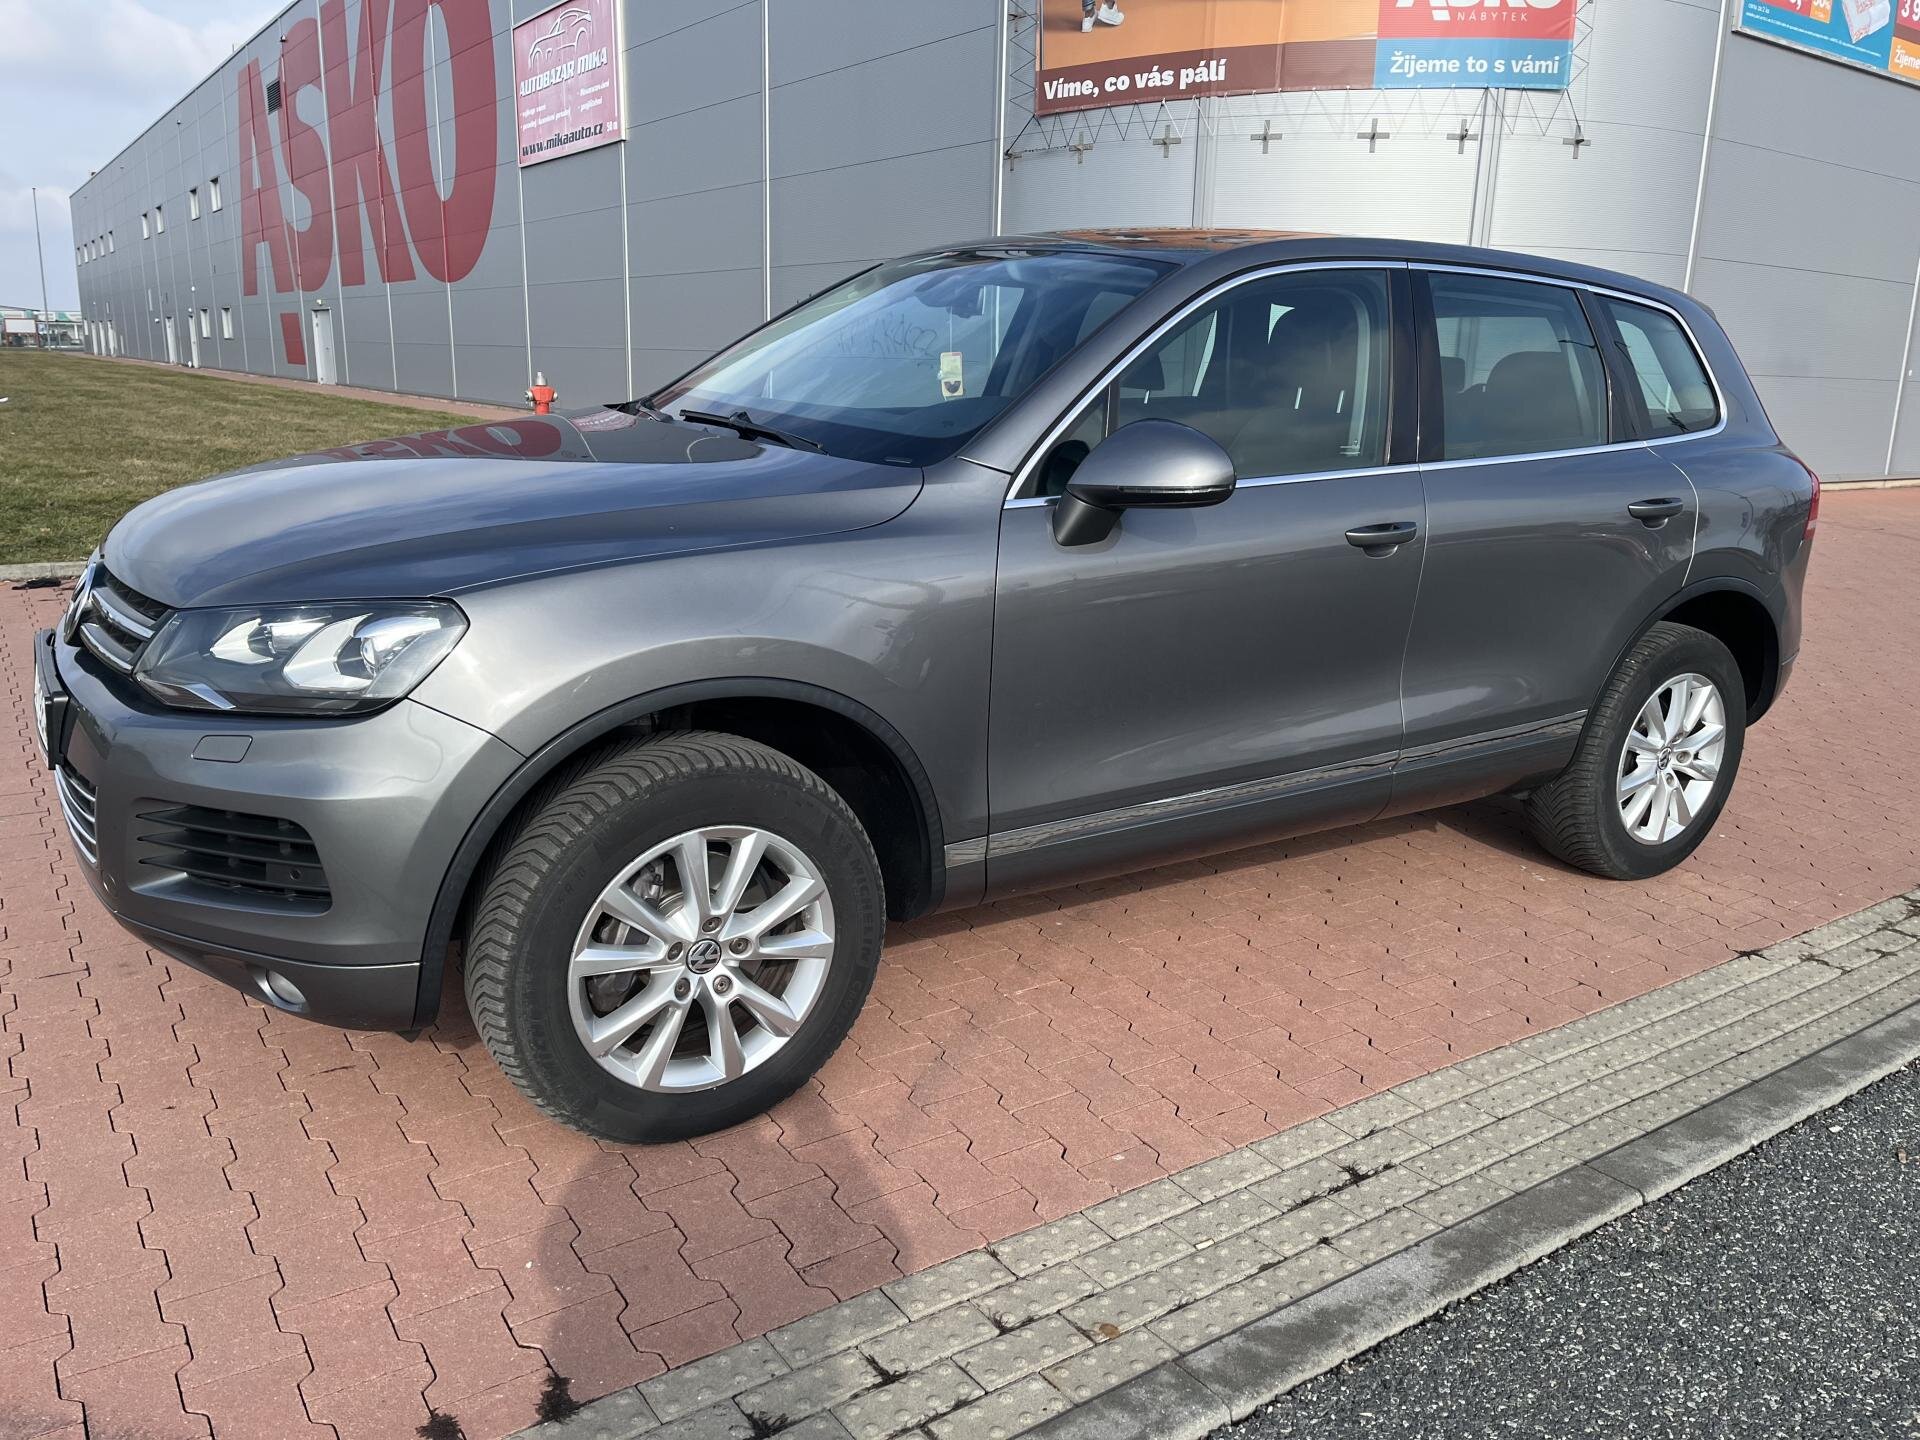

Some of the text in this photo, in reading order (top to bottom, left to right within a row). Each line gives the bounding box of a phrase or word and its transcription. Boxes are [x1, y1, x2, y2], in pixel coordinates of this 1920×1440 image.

[1457, 9, 1528, 21] NÁBYTEK
[520, 60, 575, 97] AUTOBAZAR
[577, 46, 608, 76] MIKA
[1044, 58, 1227, 100] Víme, co vás pálí
[1390, 50, 1560, 78] Žijeme to s vámi
[238, 0, 497, 296] ASKO
[522, 123, 603, 156] www.mikaauto.cz
